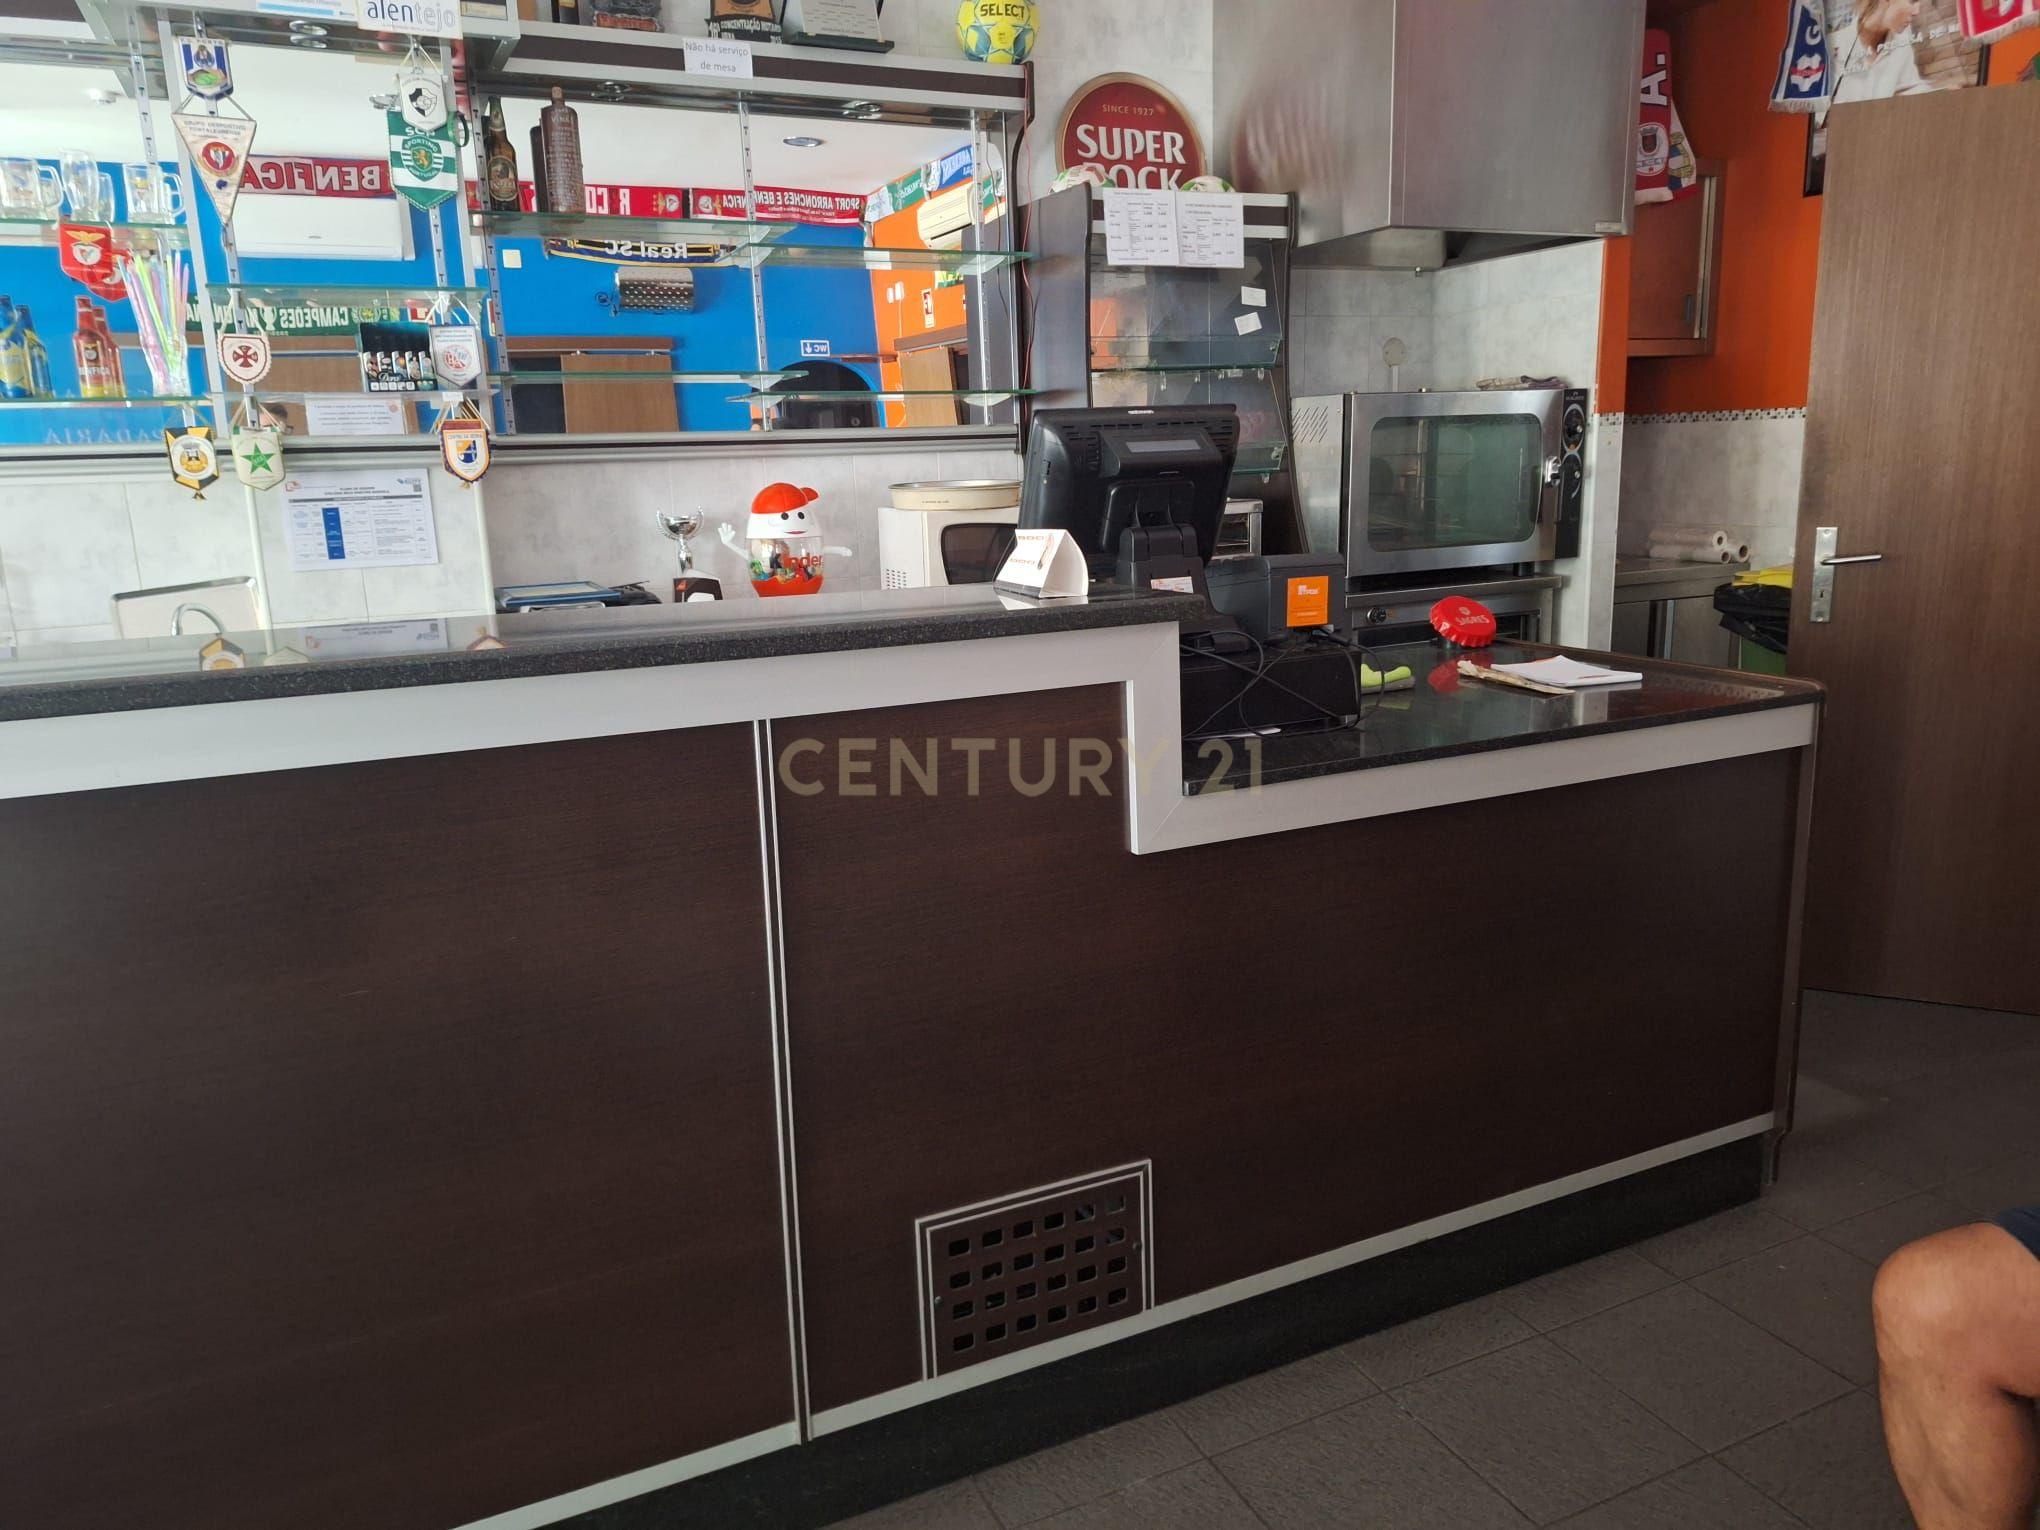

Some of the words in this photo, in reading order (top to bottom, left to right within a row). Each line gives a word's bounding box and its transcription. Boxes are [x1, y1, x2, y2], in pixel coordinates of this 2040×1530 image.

[367, 0, 456, 32] alentejo
[980, 3, 1025, 19] SELECT
[685, 42, 703, 51] Não
[705, 43, 716, 52] há
[718, 46, 749, 56] serviço
[700, 60, 711, 70] de
[713, 63, 736, 72] mesa
[1102, 103, 1129, 114] SINCE
[1133, 106, 1155, 116] 1927
[1076, 124, 1187, 164] SUPER
[1455, 614, 1491, 626] SAGRES
